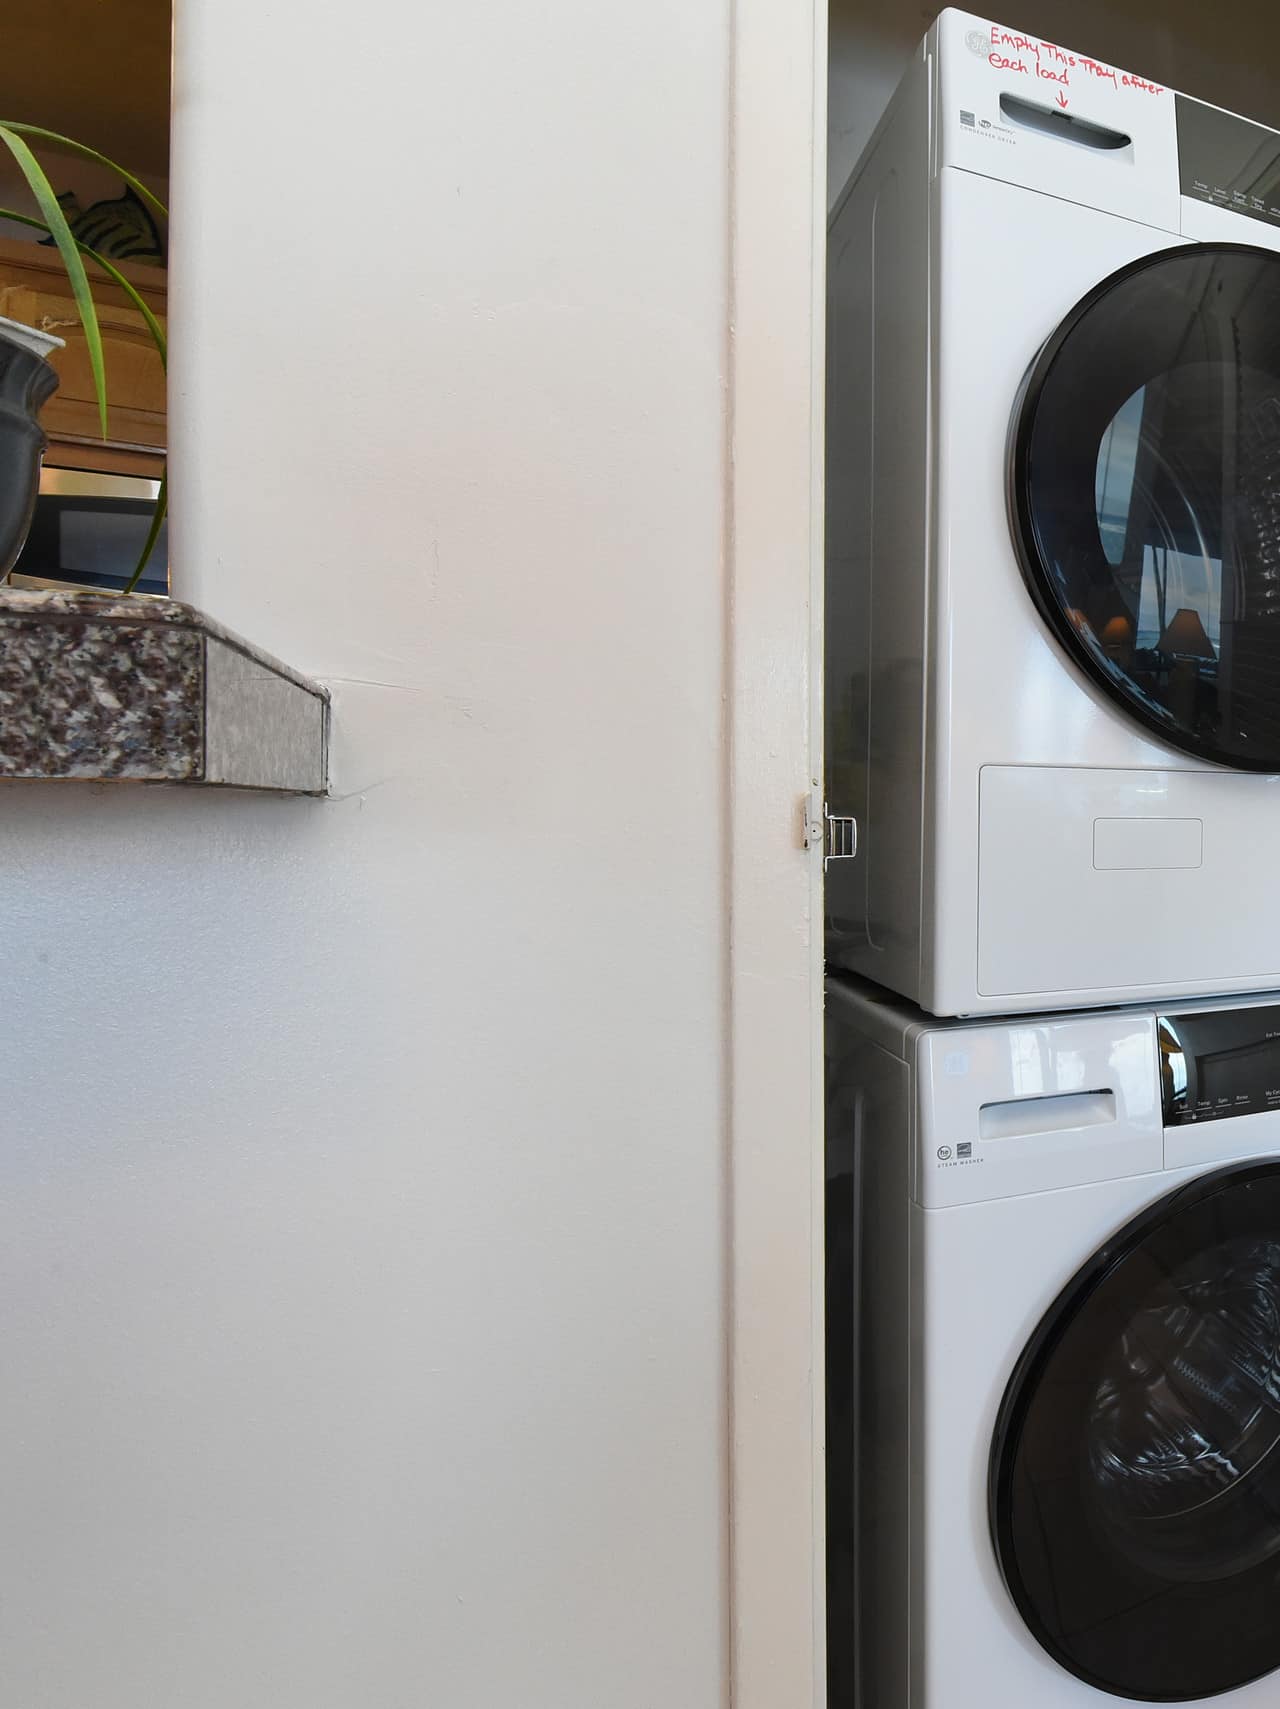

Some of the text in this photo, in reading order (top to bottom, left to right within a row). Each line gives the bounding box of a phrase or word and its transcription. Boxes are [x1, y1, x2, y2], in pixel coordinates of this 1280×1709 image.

[988, 53, 1070, 86] each load
[990, 27, 1040, 61] Empty
[1040, 42, 1076, 67] This
[1121, 74, 1164, 96] after
